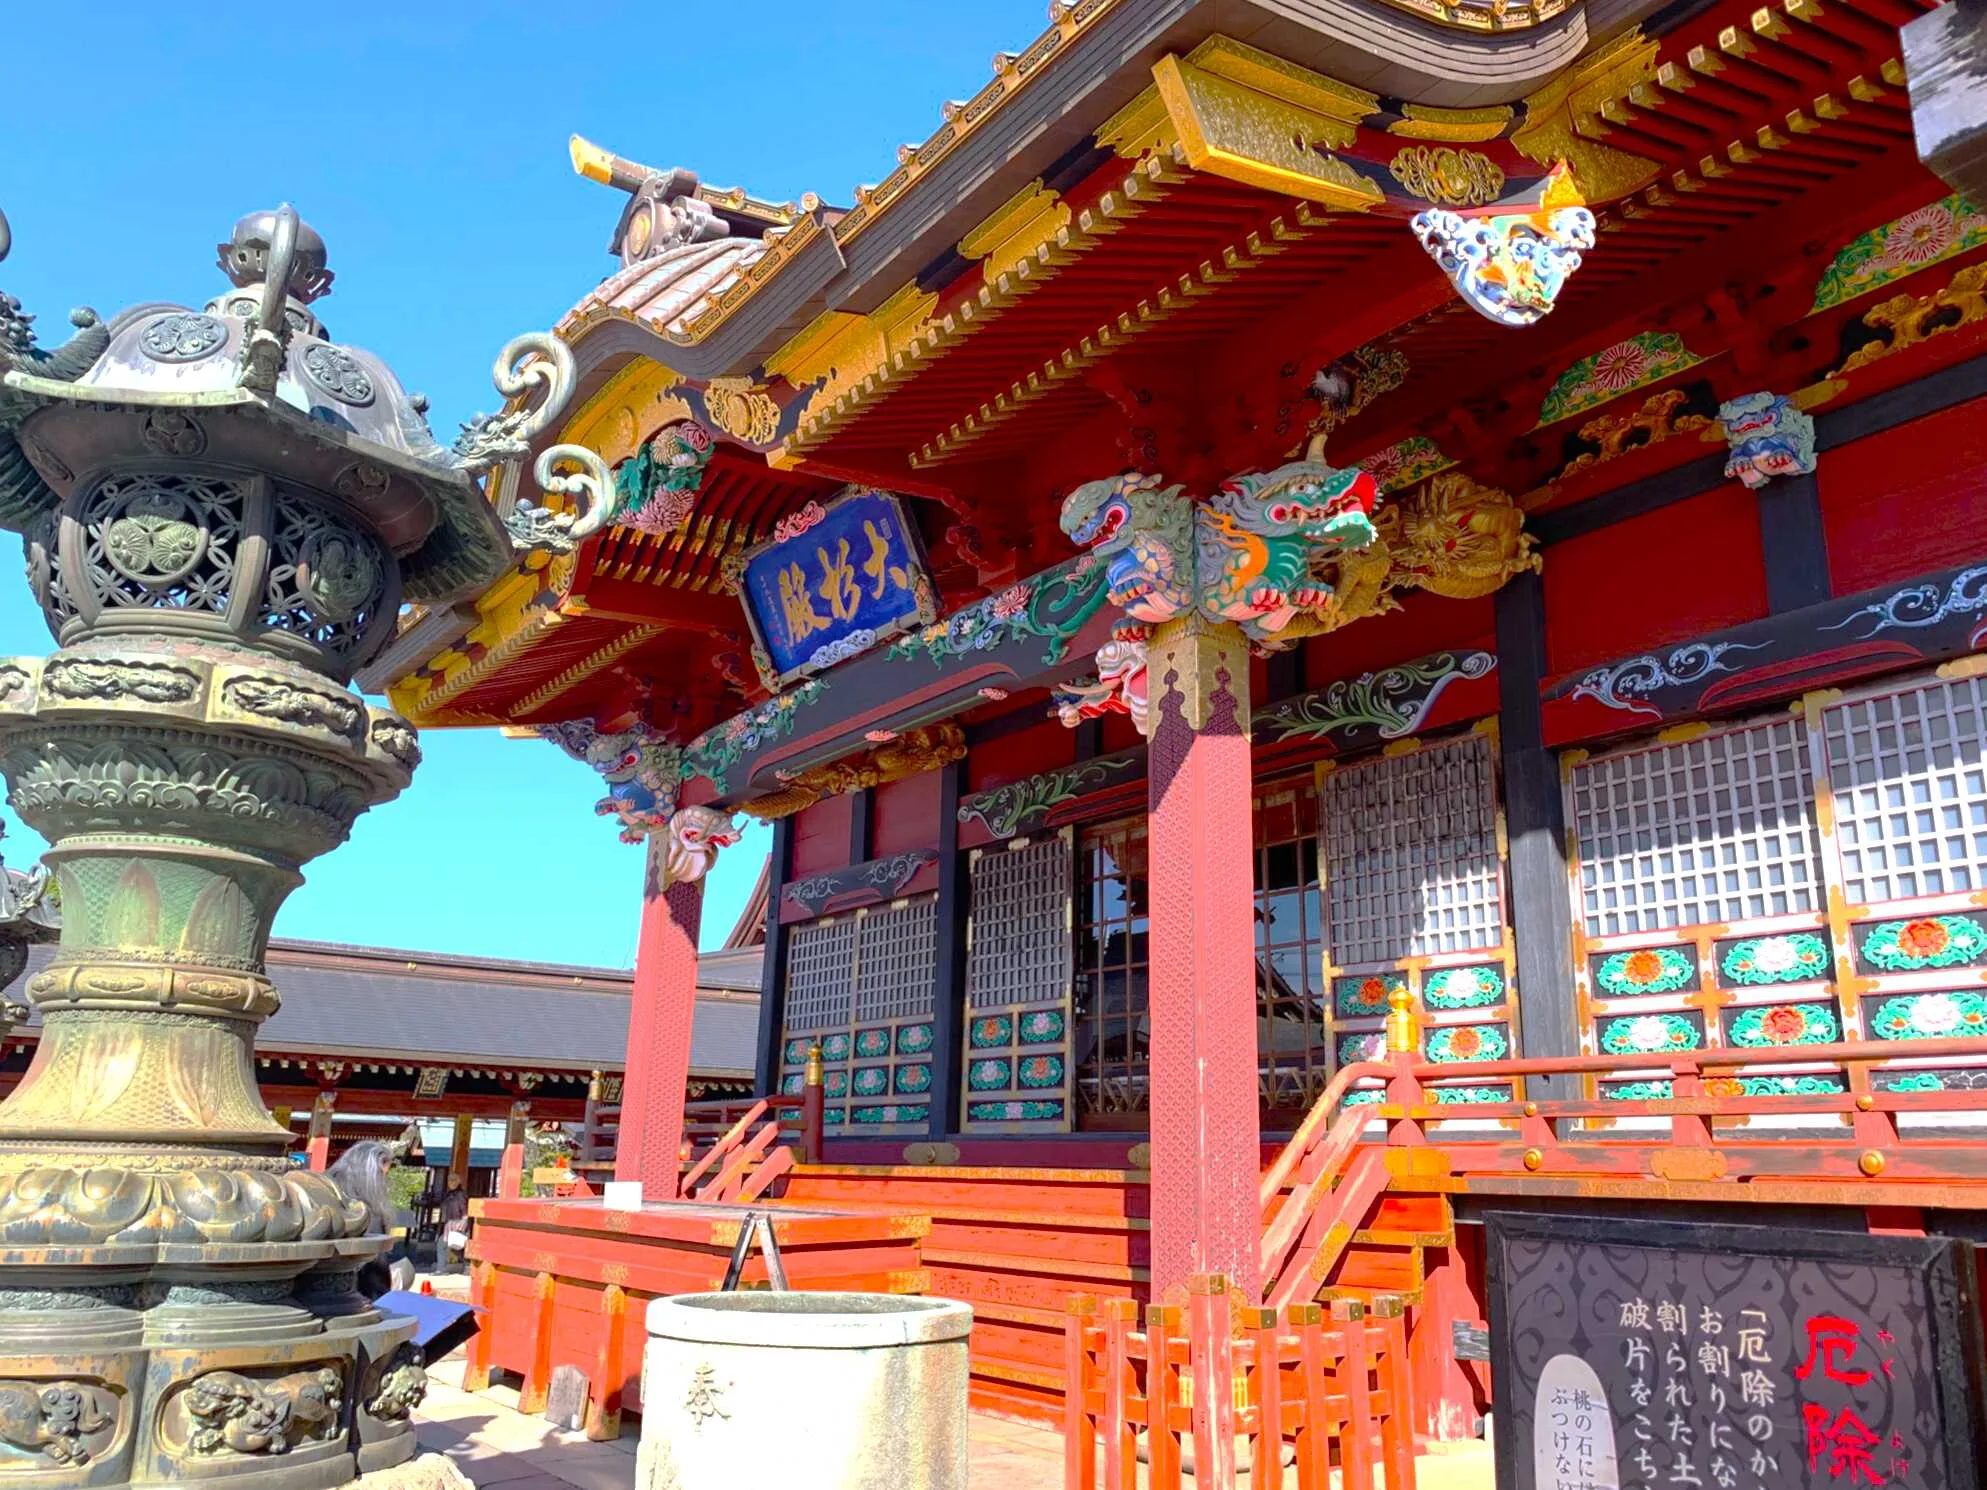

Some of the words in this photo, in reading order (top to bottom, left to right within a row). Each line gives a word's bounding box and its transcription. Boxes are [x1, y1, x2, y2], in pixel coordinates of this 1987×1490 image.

[1618, 1296, 1659, 1490] 破片をこち
[1656, 1299, 1703, 1487] 割られた土
[1697, 1305, 1740, 1488] お割りにな
[1737, 1309, 1779, 1490] 「厄除のか
[1794, 1316, 1888, 1486] 厄除
[1876, 1329, 1896, 1380] やく
[1890, 1428, 1910, 1479] よけ
